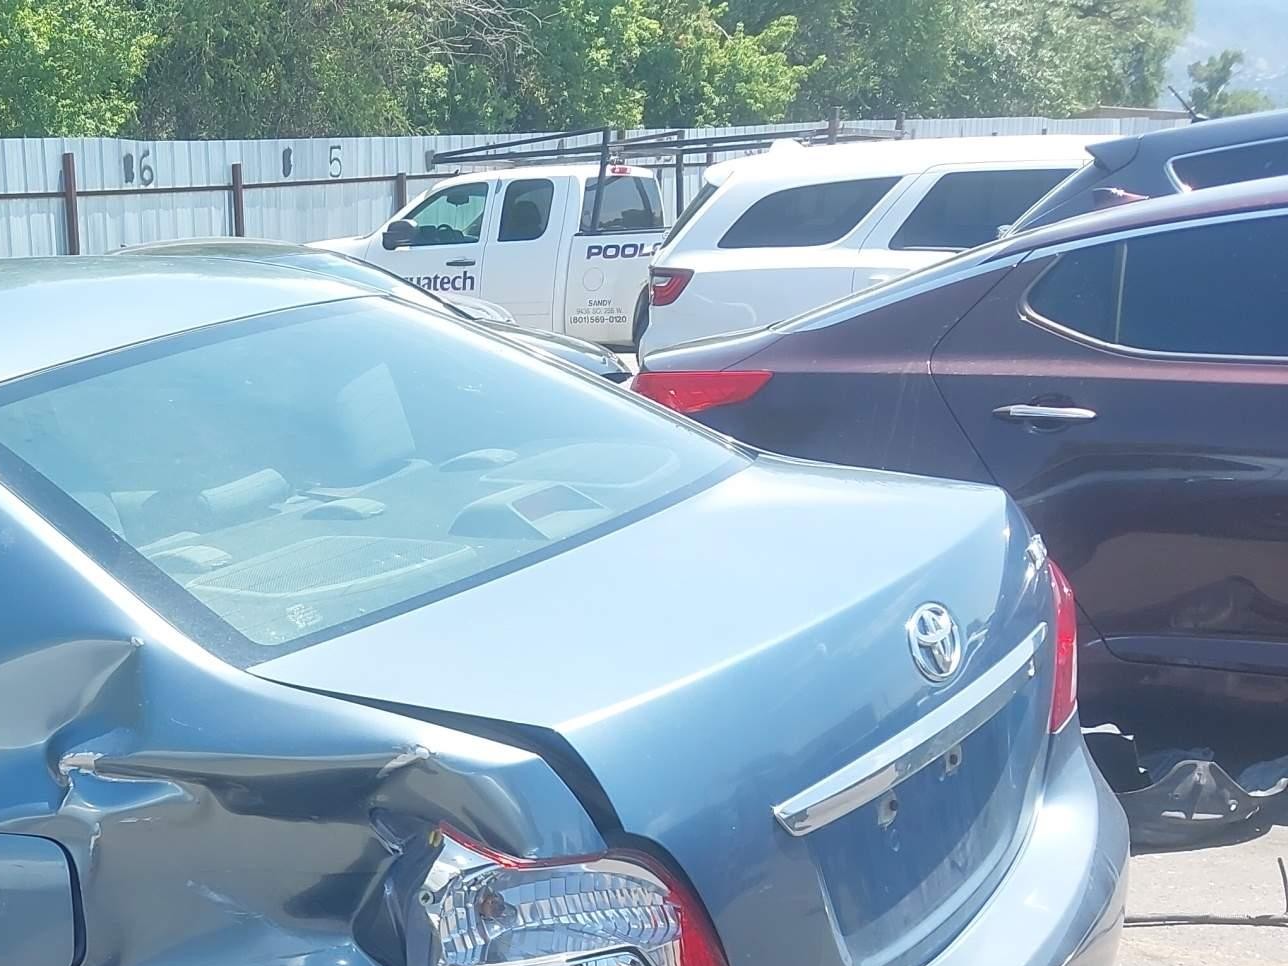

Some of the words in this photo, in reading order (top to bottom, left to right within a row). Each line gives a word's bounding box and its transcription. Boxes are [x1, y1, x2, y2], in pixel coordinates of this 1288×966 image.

[140, 147, 153, 187] 6
[329, 145, 342, 178] 5
[587, 299, 612, 307] SANDY
